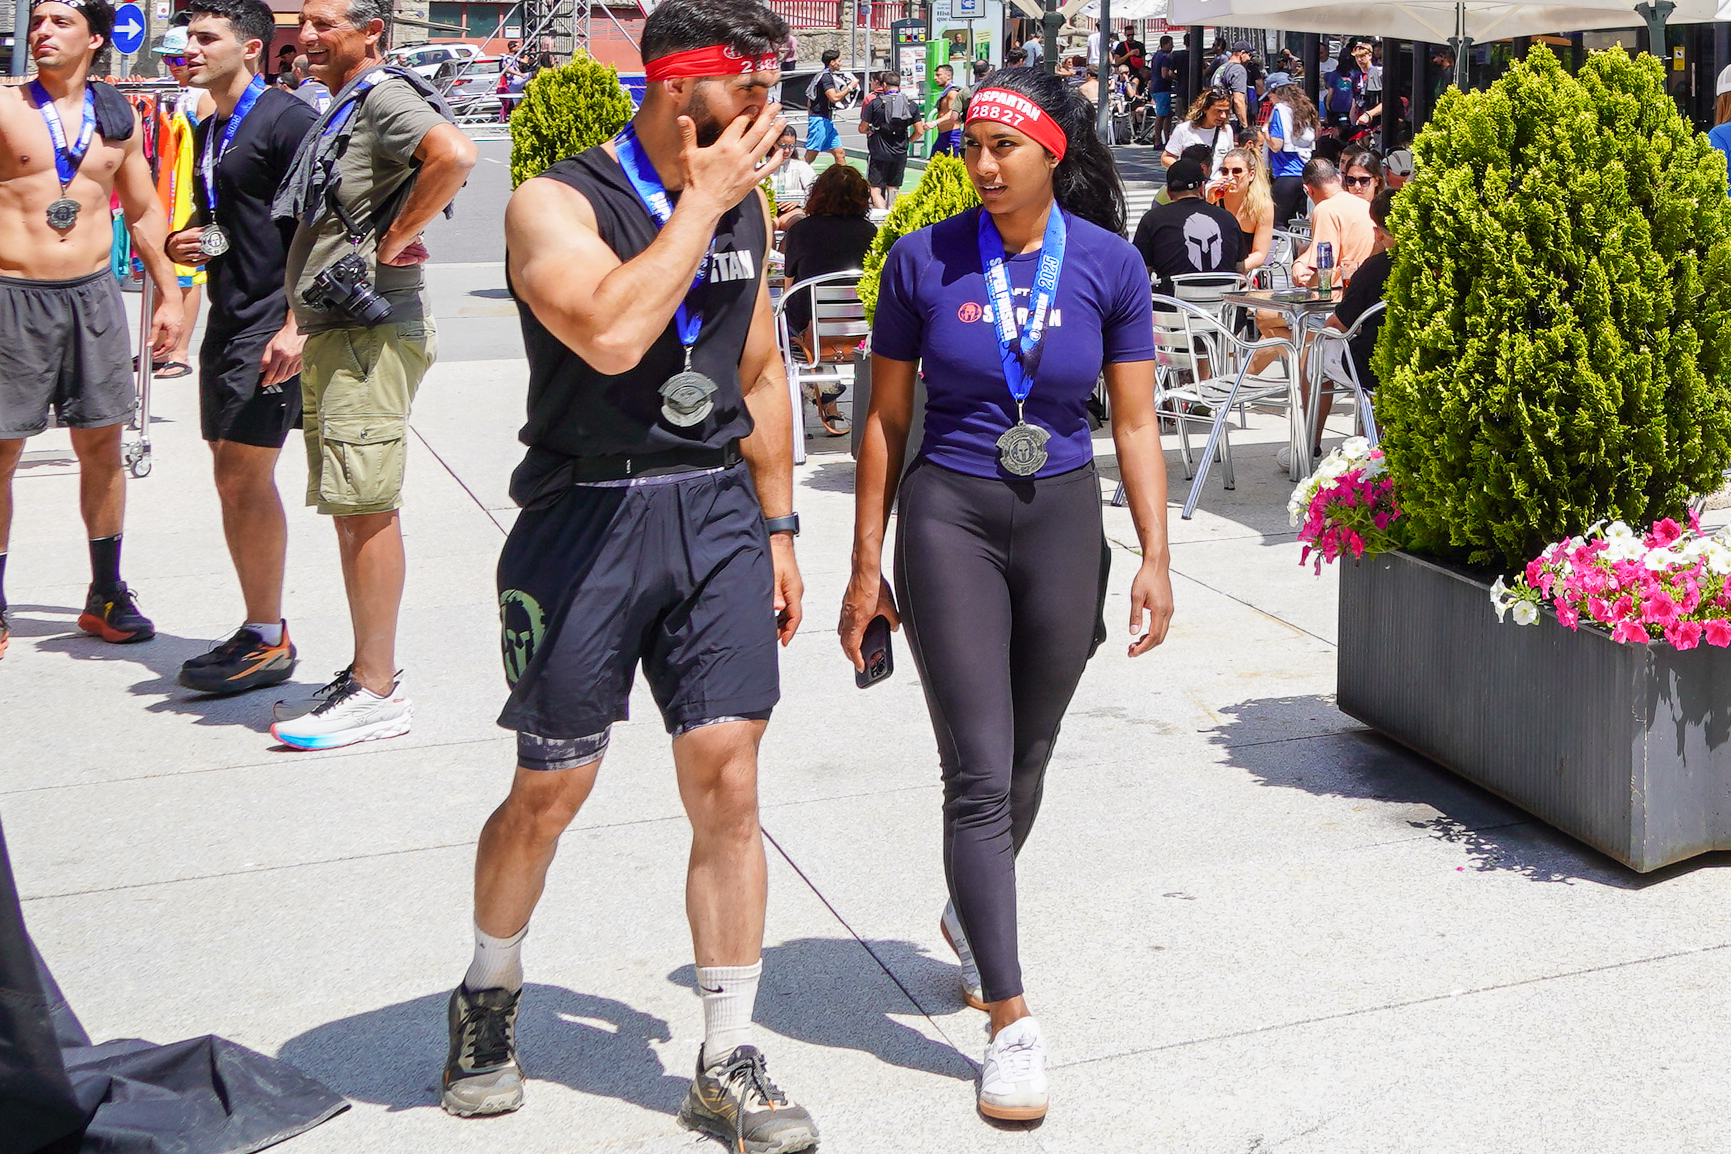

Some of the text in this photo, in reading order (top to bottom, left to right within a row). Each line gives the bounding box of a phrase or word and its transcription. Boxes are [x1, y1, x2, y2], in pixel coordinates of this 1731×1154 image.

[972, 105, 1024, 126] 28827
[981, 91, 1040, 121] SPARTAN
[989, 257, 1008, 292] SUPER
[1038, 254, 1060, 291] 2025
[996, 291, 1018, 341] FINISHER
